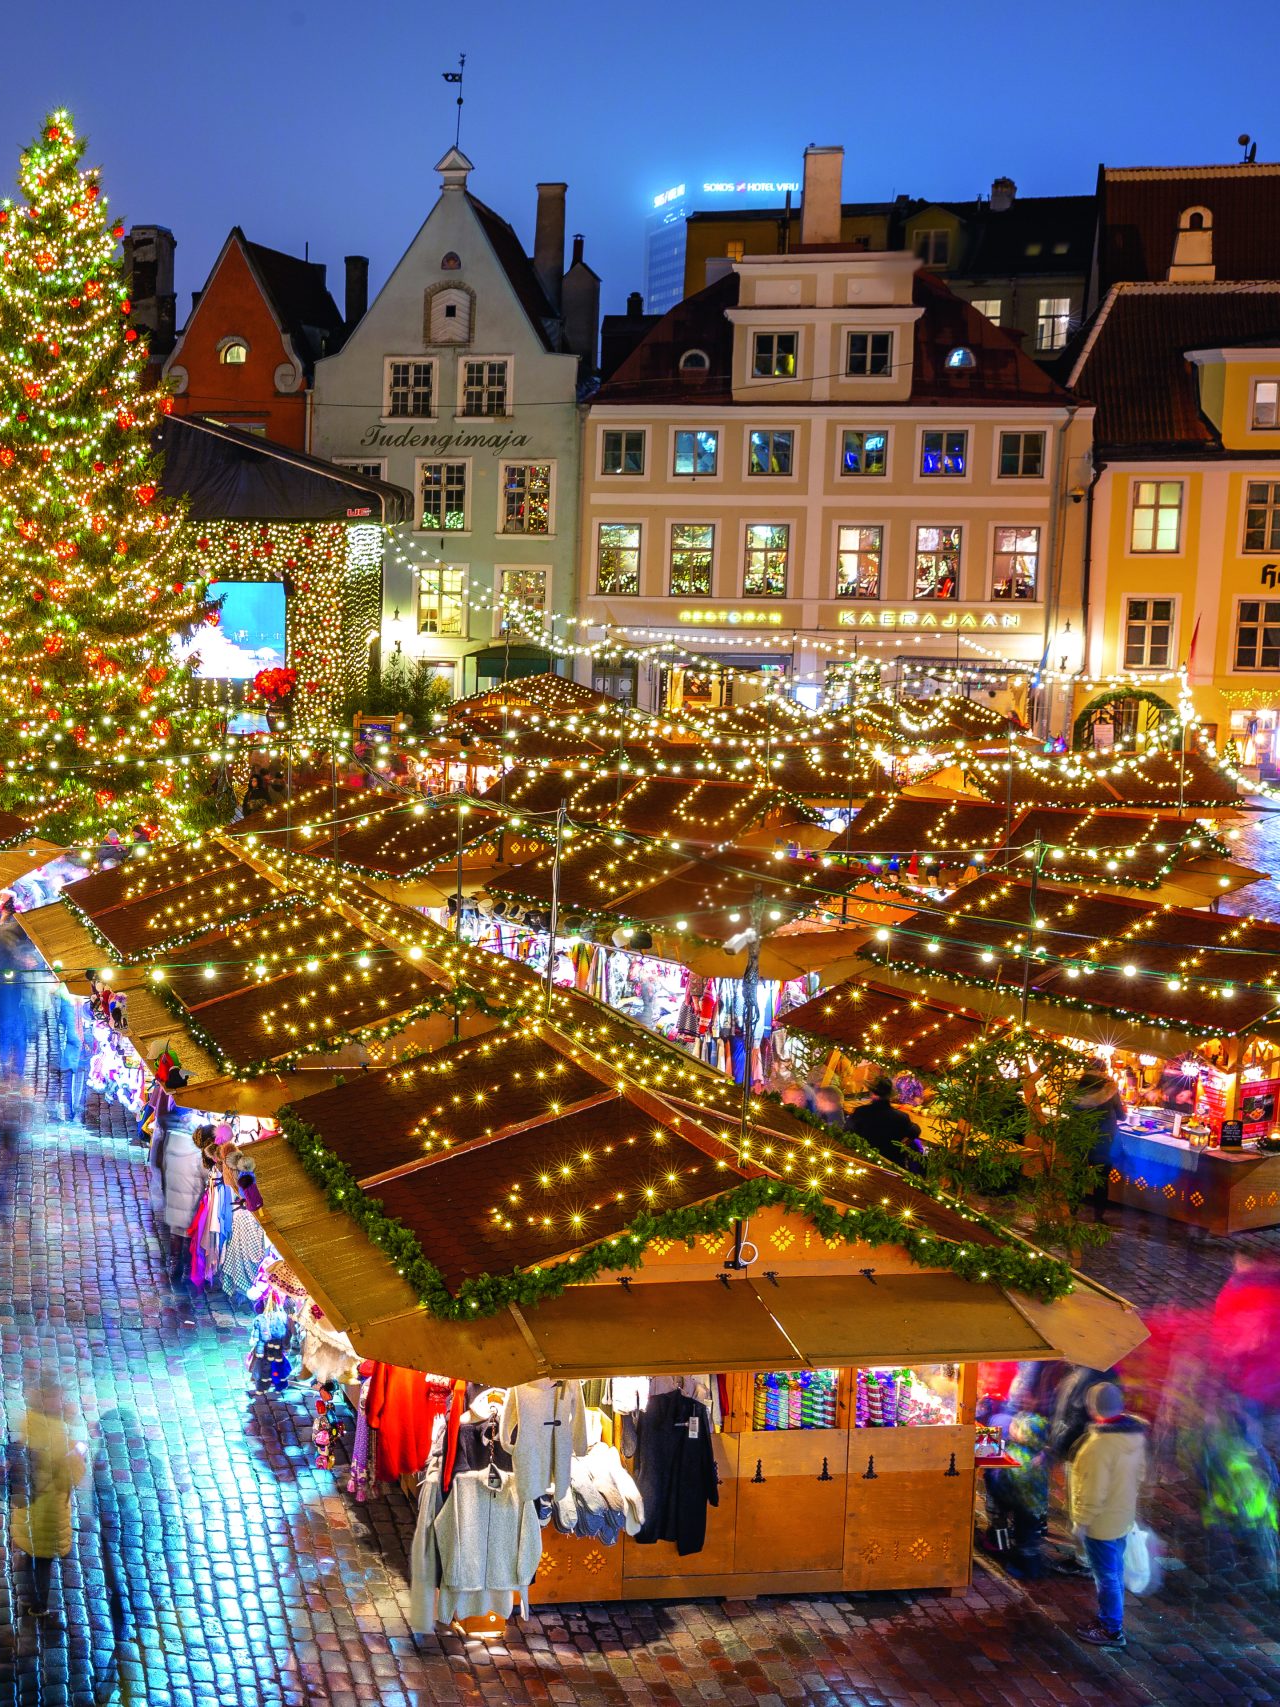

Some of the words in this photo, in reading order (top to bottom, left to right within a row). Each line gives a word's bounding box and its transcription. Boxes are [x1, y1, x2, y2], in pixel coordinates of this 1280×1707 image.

[703, 183, 734, 192] SOKOS
[747, 183, 775, 192] HOTEL
[776, 183, 799, 192] VIRU
[360, 424, 533, 456] Tudengimaja
[679, 610, 782, 624] RESTORAN
[840, 611, 1019, 627] KAERAJAAN
